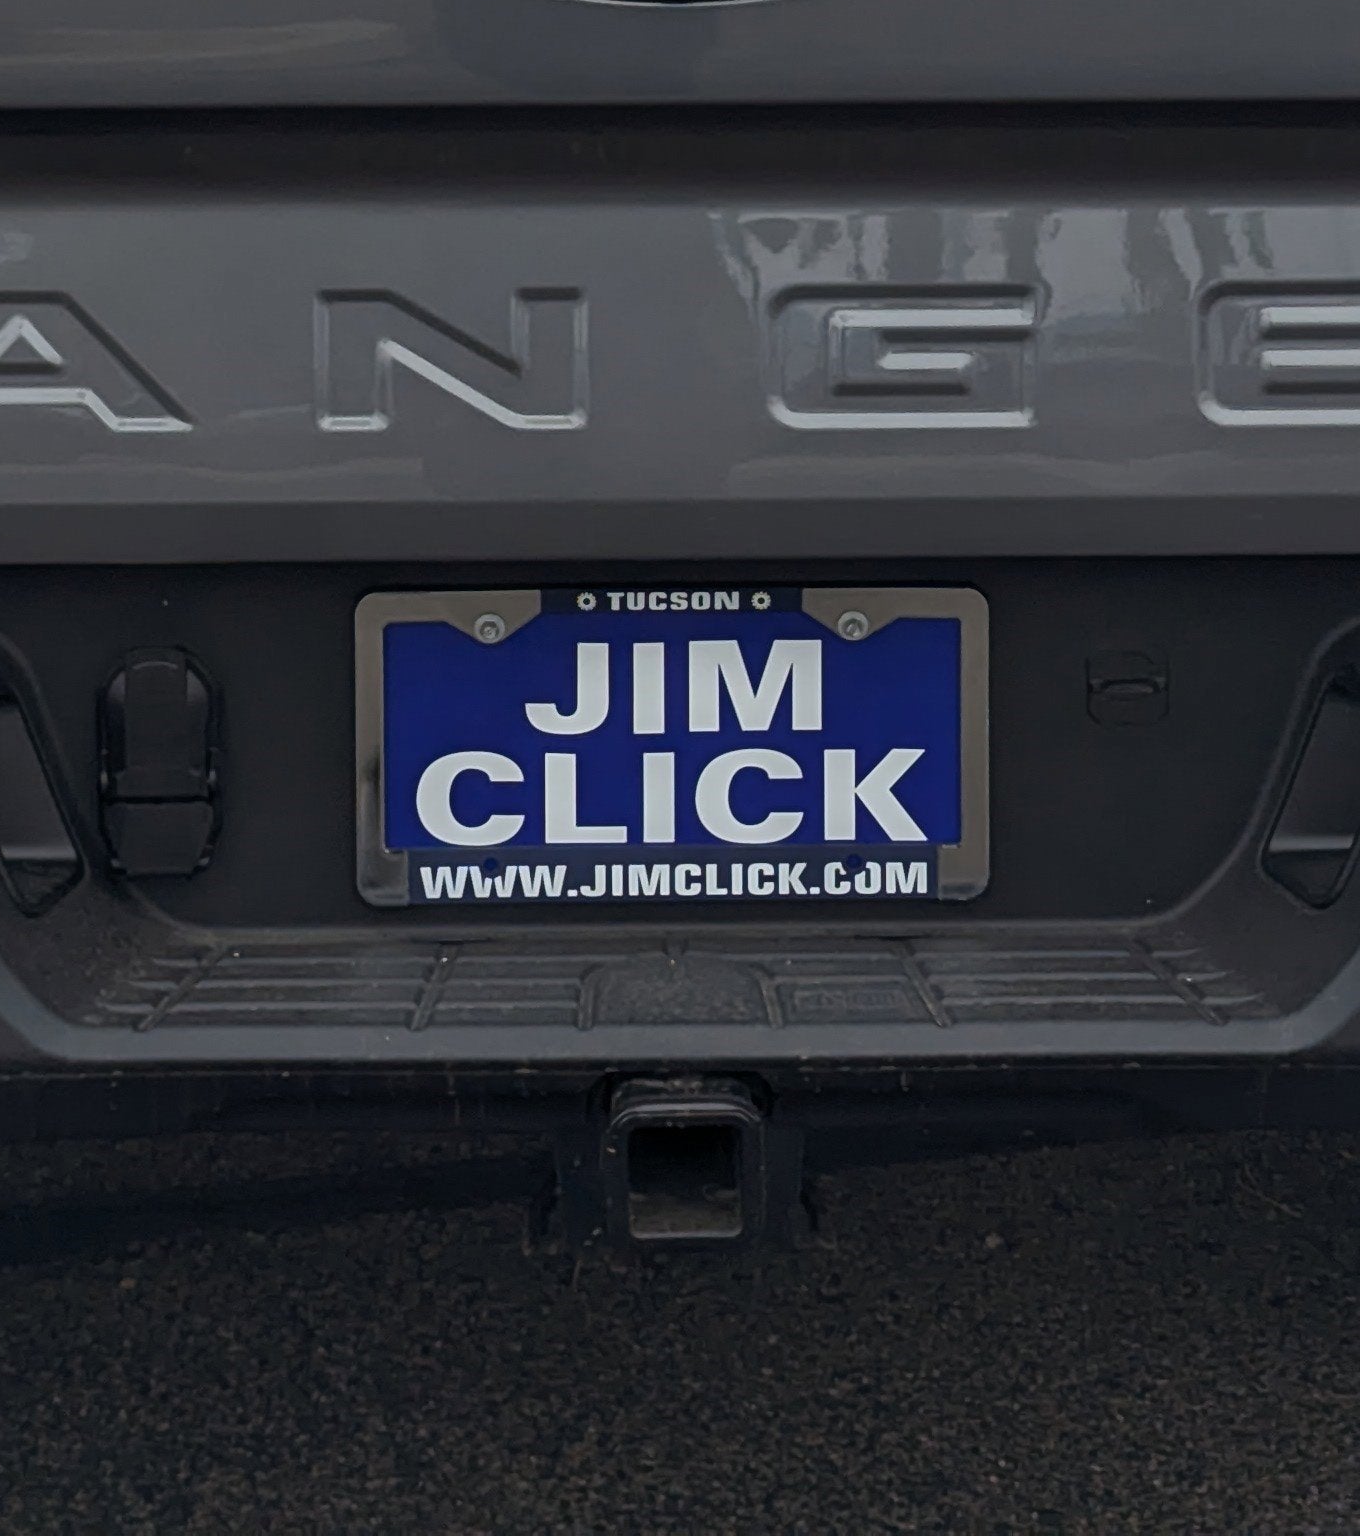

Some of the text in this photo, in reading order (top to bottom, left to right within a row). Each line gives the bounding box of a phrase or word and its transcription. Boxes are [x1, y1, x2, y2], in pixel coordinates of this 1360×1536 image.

[607, 591, 740, 612] TUCSON
[524, 639, 824, 736] JIM
[415, 747, 929, 847] CLICK
[419, 861, 928, 900] WWW.JIMCLICK.COM
